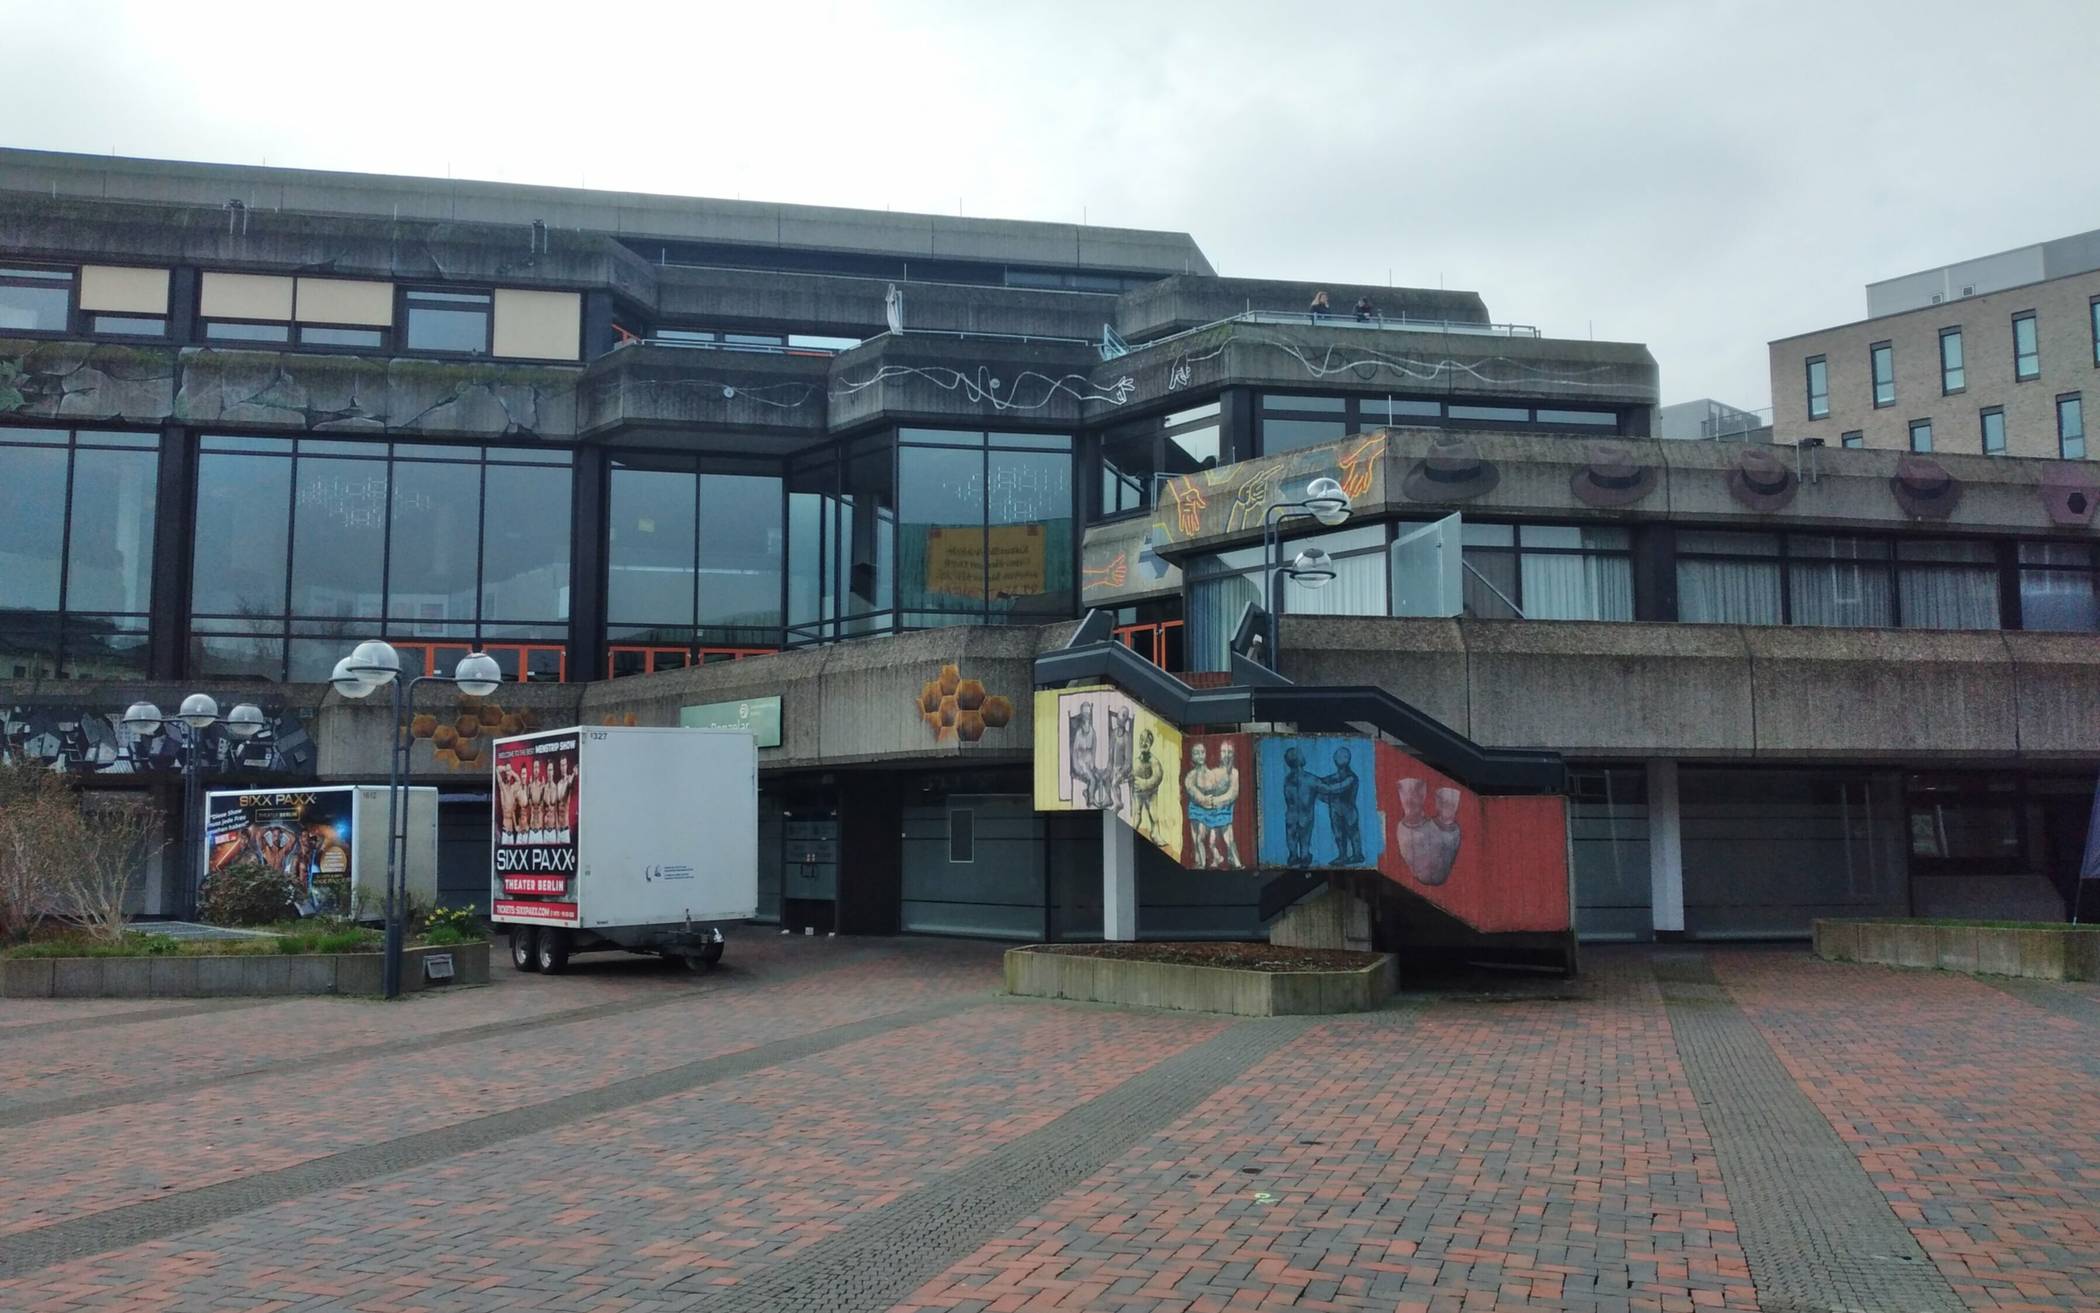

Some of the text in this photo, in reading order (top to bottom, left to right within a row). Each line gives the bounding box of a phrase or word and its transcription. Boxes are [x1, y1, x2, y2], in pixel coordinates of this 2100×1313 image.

[560, 740, 576, 750] SHOW
[240, 794, 272, 807] SIXX
[496, 849, 529, 871] SIXX
[505, 879, 564, 892] THEATER BERLIN
